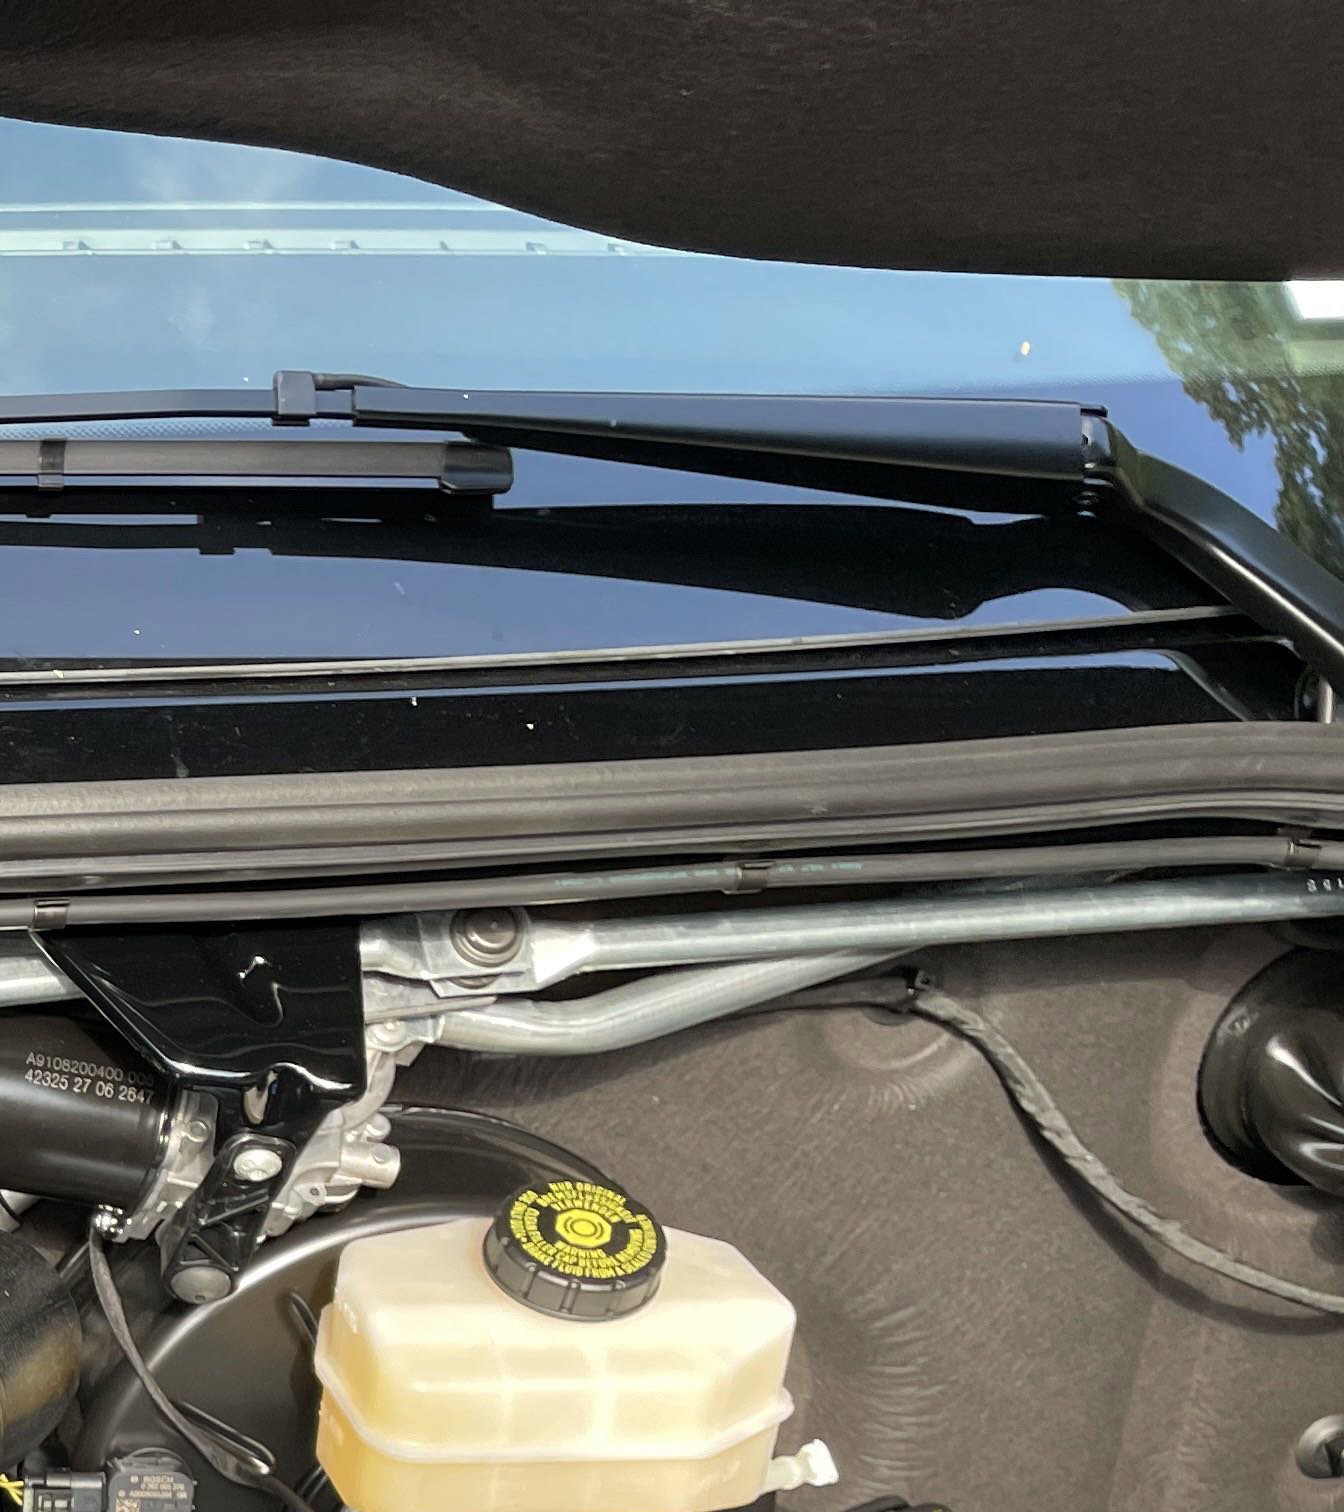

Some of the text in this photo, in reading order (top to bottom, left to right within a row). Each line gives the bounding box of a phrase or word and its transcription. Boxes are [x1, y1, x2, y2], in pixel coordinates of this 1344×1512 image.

[25, 1069, 154, 1104] 42325 27 06 2647
